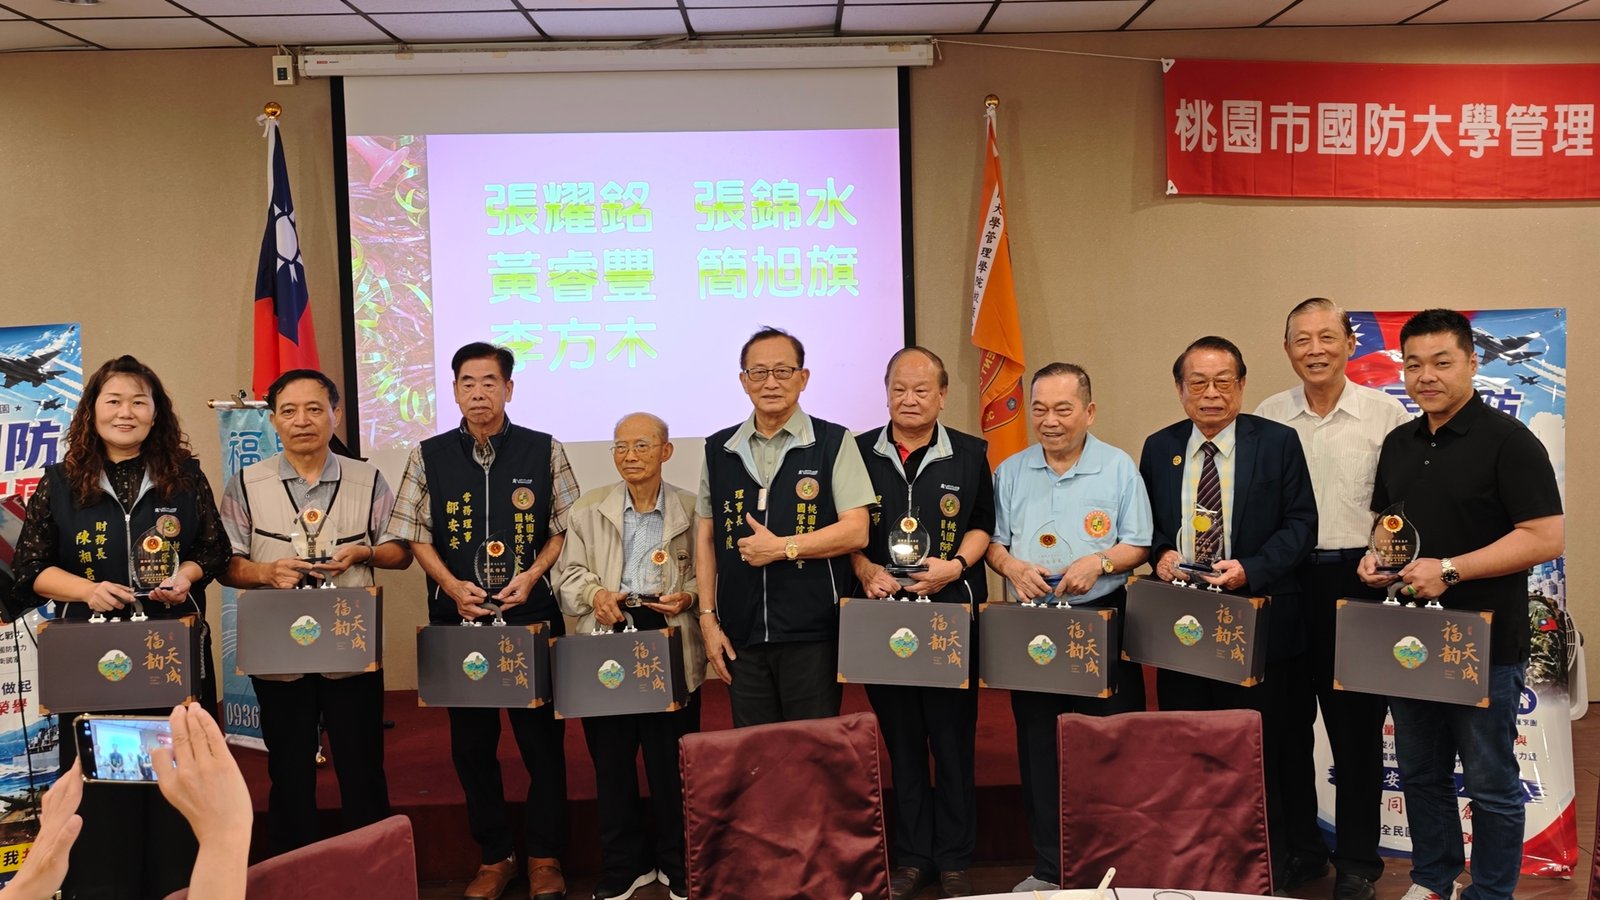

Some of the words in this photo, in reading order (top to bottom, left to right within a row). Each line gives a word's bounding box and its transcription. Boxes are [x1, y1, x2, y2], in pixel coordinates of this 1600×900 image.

[1175, 98, 1596, 158] 桃園市國防大學管理
[484, 181, 654, 236] 張耀銘
[693, 177, 858, 232] 張錦水
[488, 248, 657, 304] 黃睿豐
[696, 245, 860, 299] 簡旭旗
[490, 316, 658, 372] 李方木
[0, 420, 61, 472] 防
[462, 492, 473, 543] 常務理事
[525, 512, 536, 543] 桃園市
[734, 489, 745, 527] 理事長
[94, 520, 108, 560] 財務長
[2, 680, 32, 695] 做起
[226, 702, 260, 729] 0936
[1383, 770, 1400, 789] 安
[1387, 796, 1403, 815] 同
